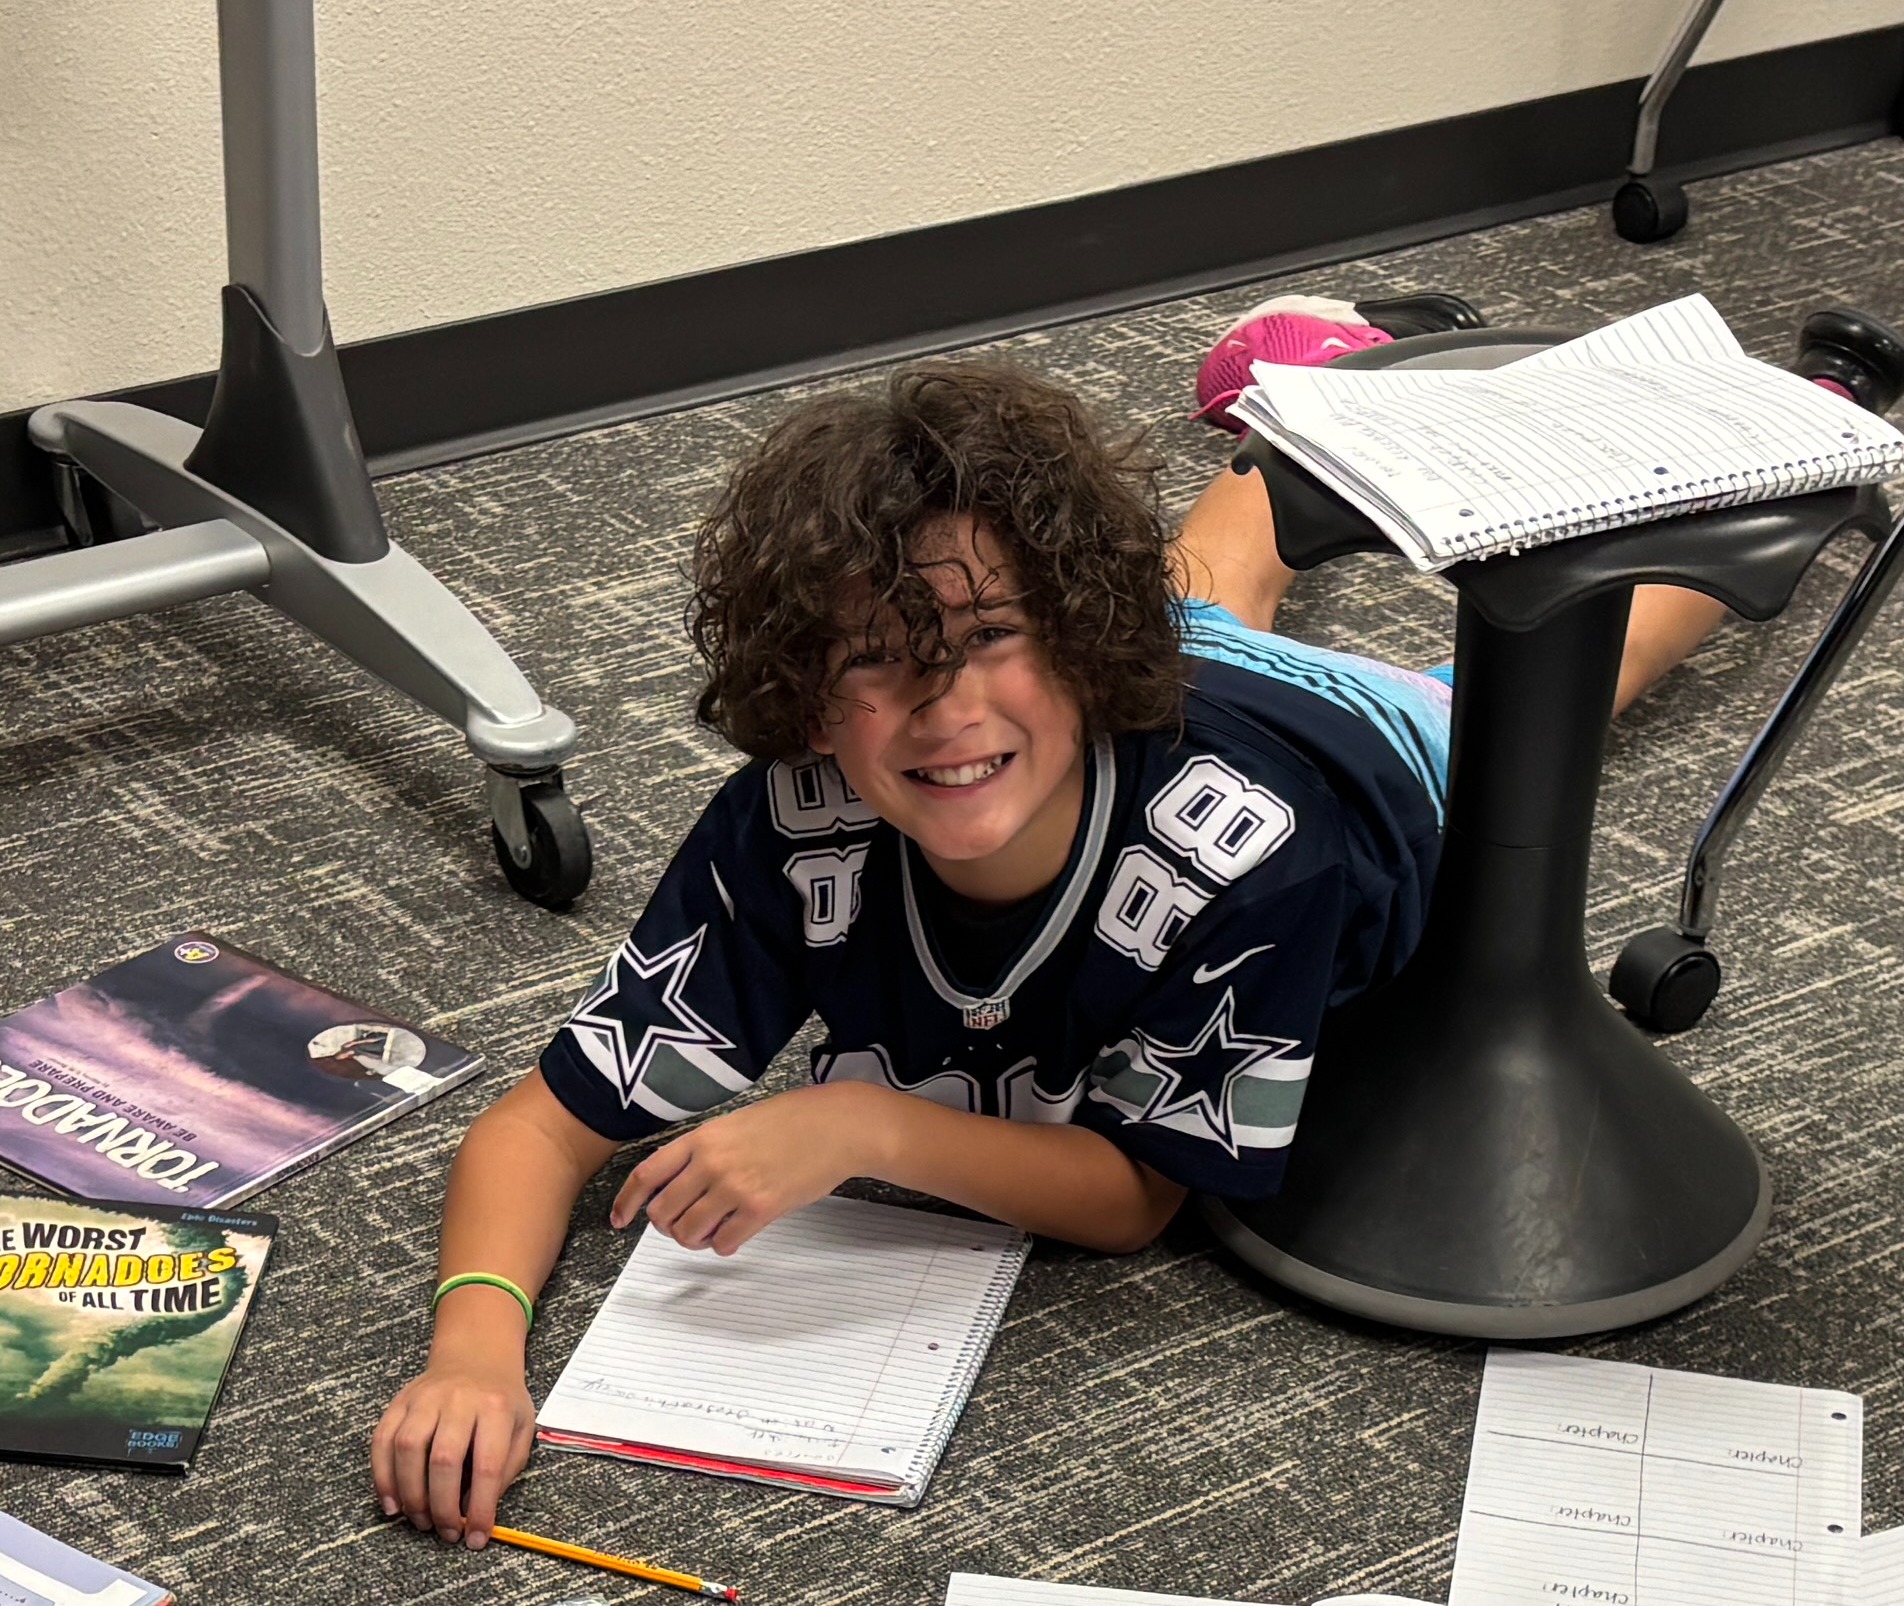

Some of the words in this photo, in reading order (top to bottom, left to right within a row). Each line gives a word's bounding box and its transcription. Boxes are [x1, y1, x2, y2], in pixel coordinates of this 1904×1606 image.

[26, 1059, 94, 1093] PREPARE
[91, 1089, 126, 1107] AND
[122, 1104, 176, 1135] AWARE
[175, 1128, 197, 1142] BE
[22, 1223, 146, 1255] WORST
[59, 1291, 77, 1303] OF
[81, 1291, 124, 1310] ALL
[133, 1278, 222, 1313] TIME
